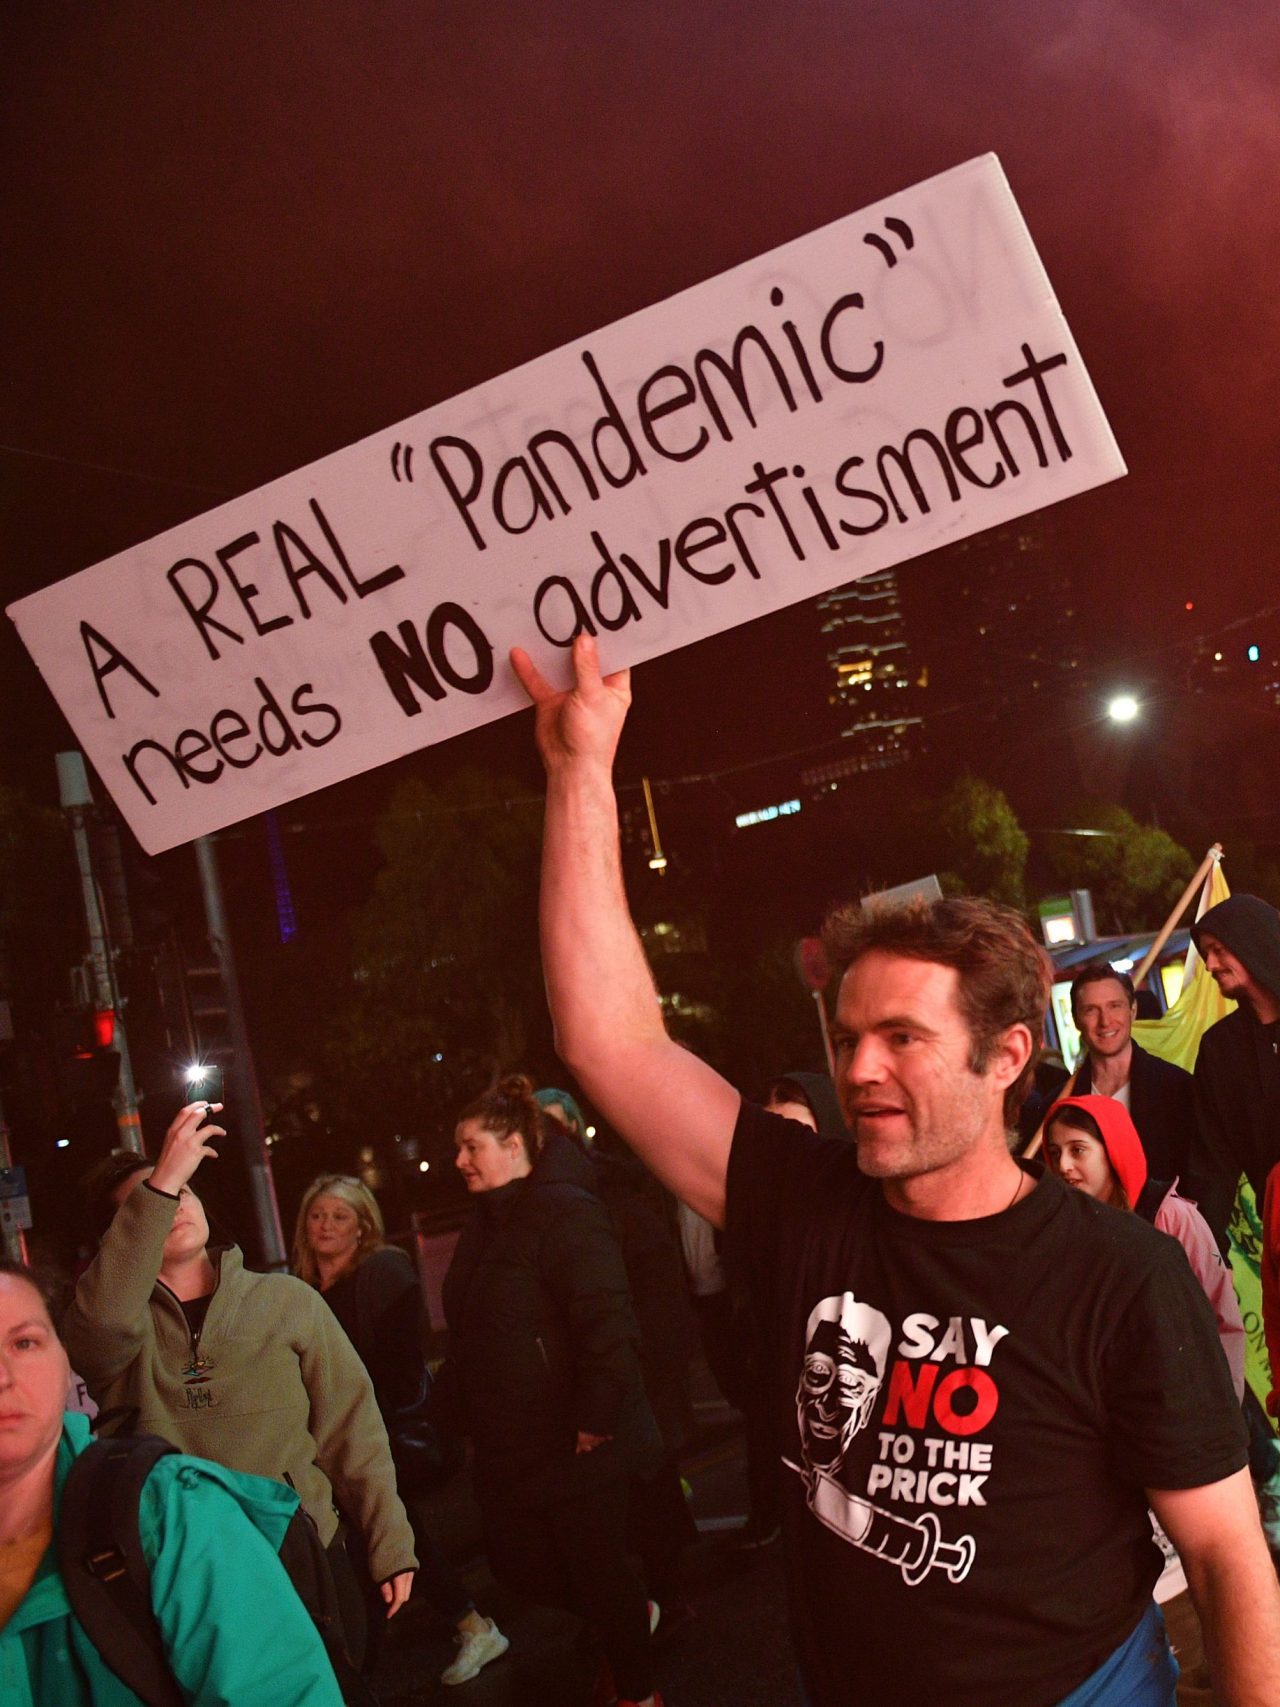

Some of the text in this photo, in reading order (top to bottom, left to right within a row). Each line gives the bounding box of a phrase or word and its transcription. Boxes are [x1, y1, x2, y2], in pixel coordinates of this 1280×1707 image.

[122, 342, 1068, 806] needs NO advertisment
[79, 620, 160, 720] A
[166, 498, 406, 661] REAL
[898, 1312, 1010, 1367] SAY
[881, 1360, 999, 1437] NO
[867, 1463, 989, 1507] PRICK
[878, 1432, 994, 1472] TO THE
